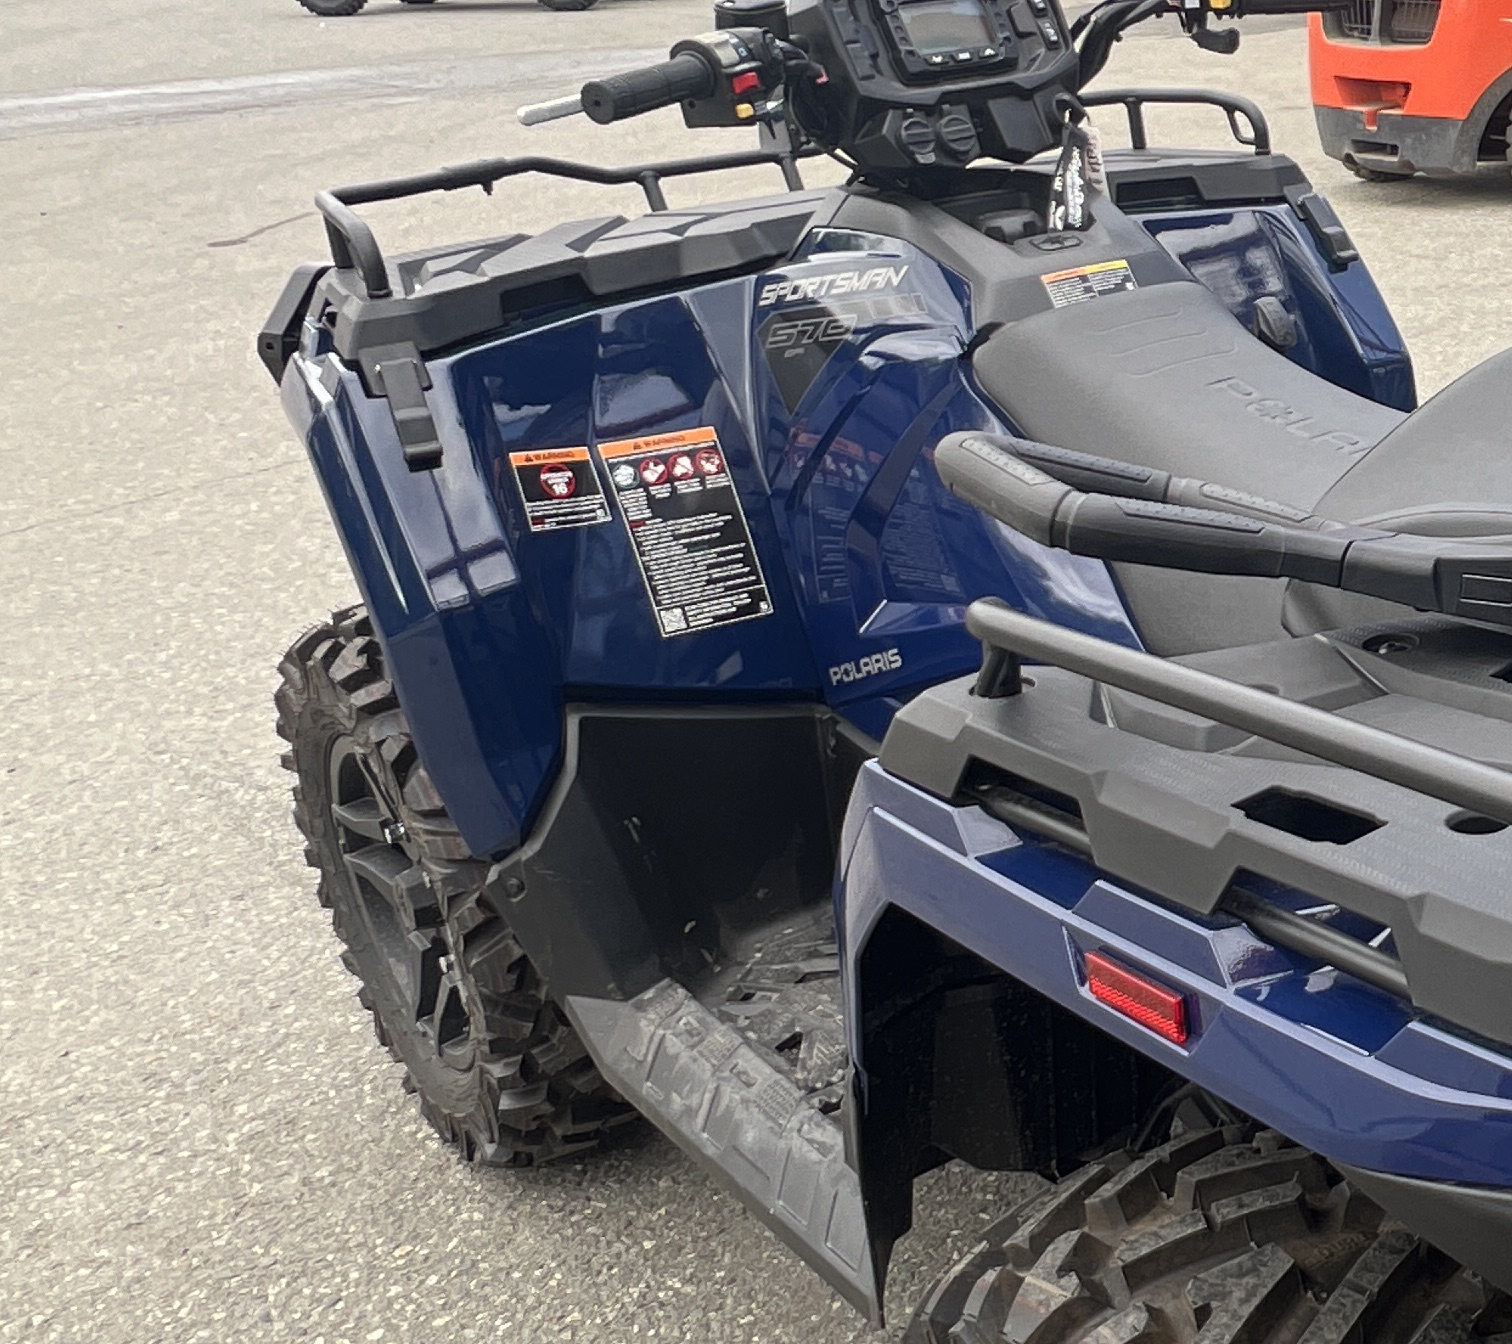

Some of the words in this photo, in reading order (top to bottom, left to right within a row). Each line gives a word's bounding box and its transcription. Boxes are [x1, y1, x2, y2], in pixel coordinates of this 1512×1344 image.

[758, 265, 910, 307] SPORTSMAN
[765, 313, 859, 350] 570
[829, 648, 903, 686] POLARIS
